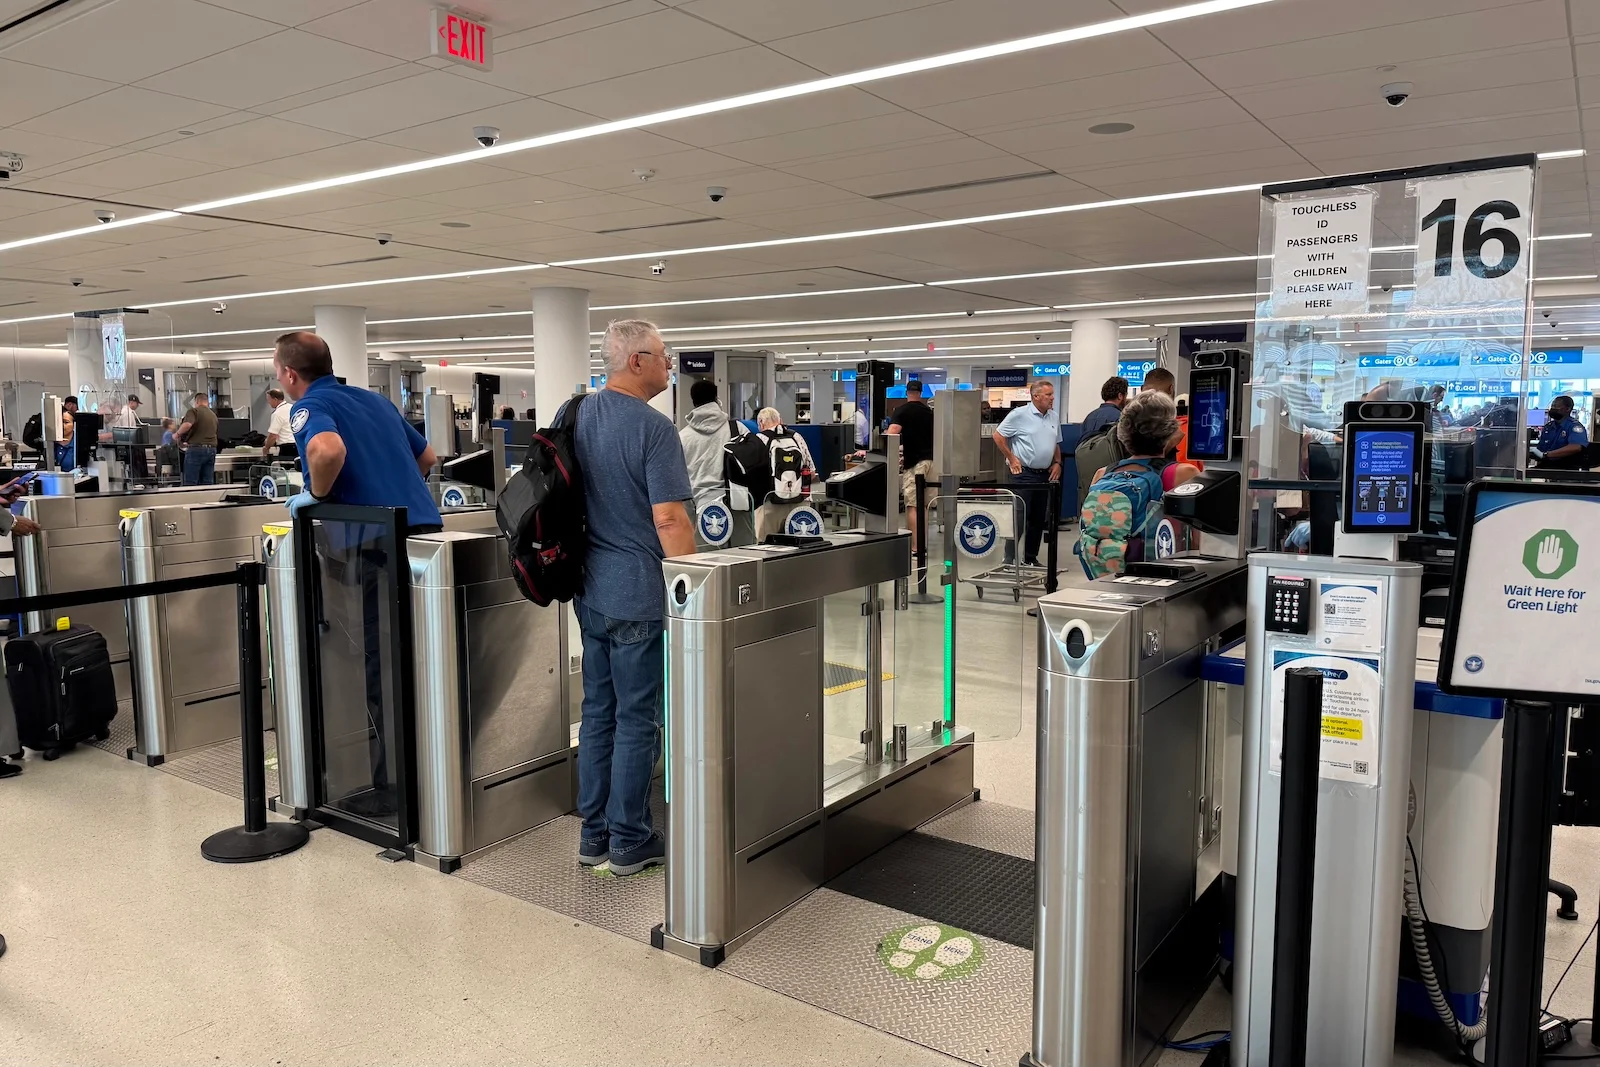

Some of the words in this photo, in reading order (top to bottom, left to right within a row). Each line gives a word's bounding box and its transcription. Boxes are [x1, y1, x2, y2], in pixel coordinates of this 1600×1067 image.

[448, 14, 486, 64] EXIT
[1292, 202, 1357, 215] TOUCHLESS
[1317, 220, 1328, 228] ID
[1287, 234, 1358, 247] PASSENGERS
[1422, 198, 1520, 279] 16
[1307, 252, 1334, 261] WITH
[1293, 267, 1347, 277] CHILDREN
[1287, 284, 1324, 293] PLEASE
[1327, 282, 1354, 291] WAIT
[1305, 300, 1332, 308] HERE
[1504, 584, 1532, 596] Wait
[1535, 587, 1564, 598] Here
[1567, 588, 1586, 599] for
[1507, 599, 1544, 611] Green
[1546, 601, 1578, 614] Light
[907, 934, 933, 945] STAND
[944, 945, 968, 956] HERE
